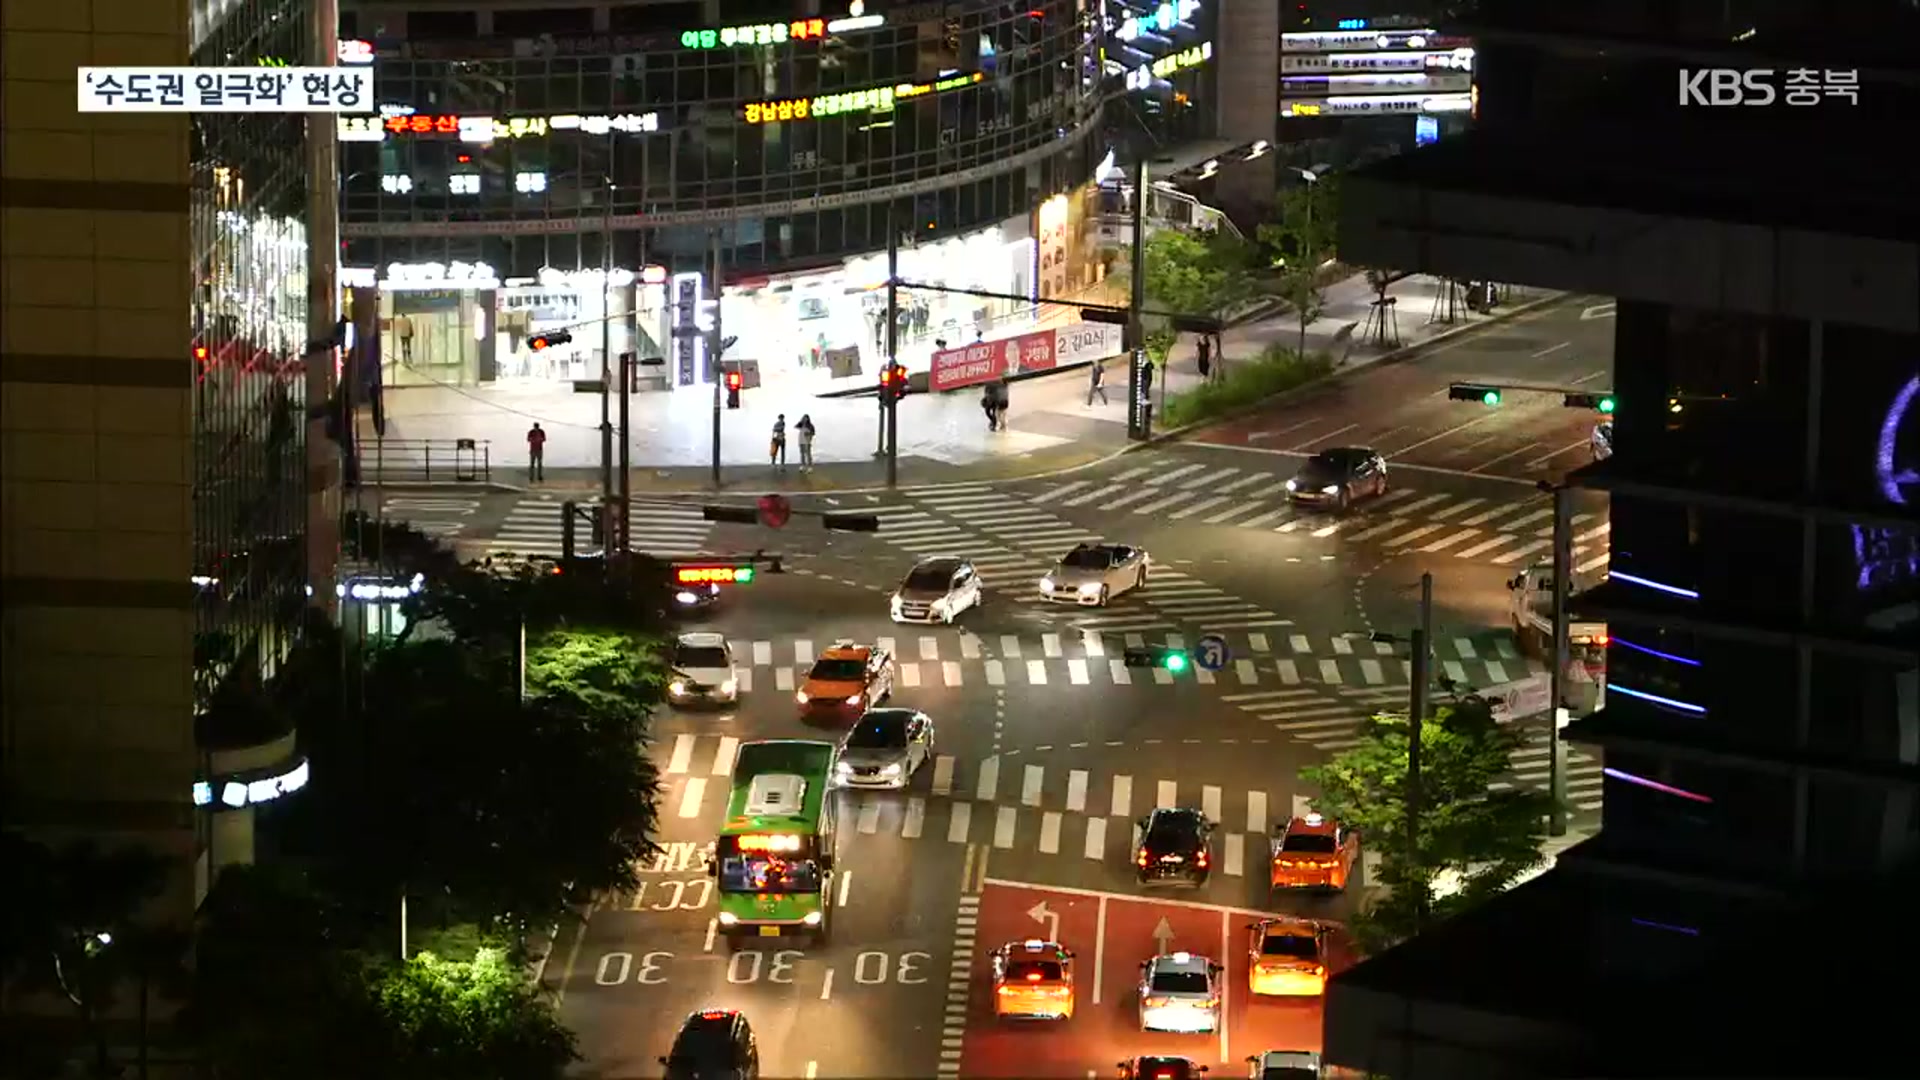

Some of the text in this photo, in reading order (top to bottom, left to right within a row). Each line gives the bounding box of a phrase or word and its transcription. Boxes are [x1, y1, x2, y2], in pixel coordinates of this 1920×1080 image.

[790, 19, 823, 39] 치과
[745, 99, 808, 122] 강남삼성
[386, 116, 458, 132] 부동산
[1058, 336, 1067, 353] 2
[595, 951, 675, 985] 30
[726, 950, 805, 985] 30
[854, 951, 932, 984] 30
